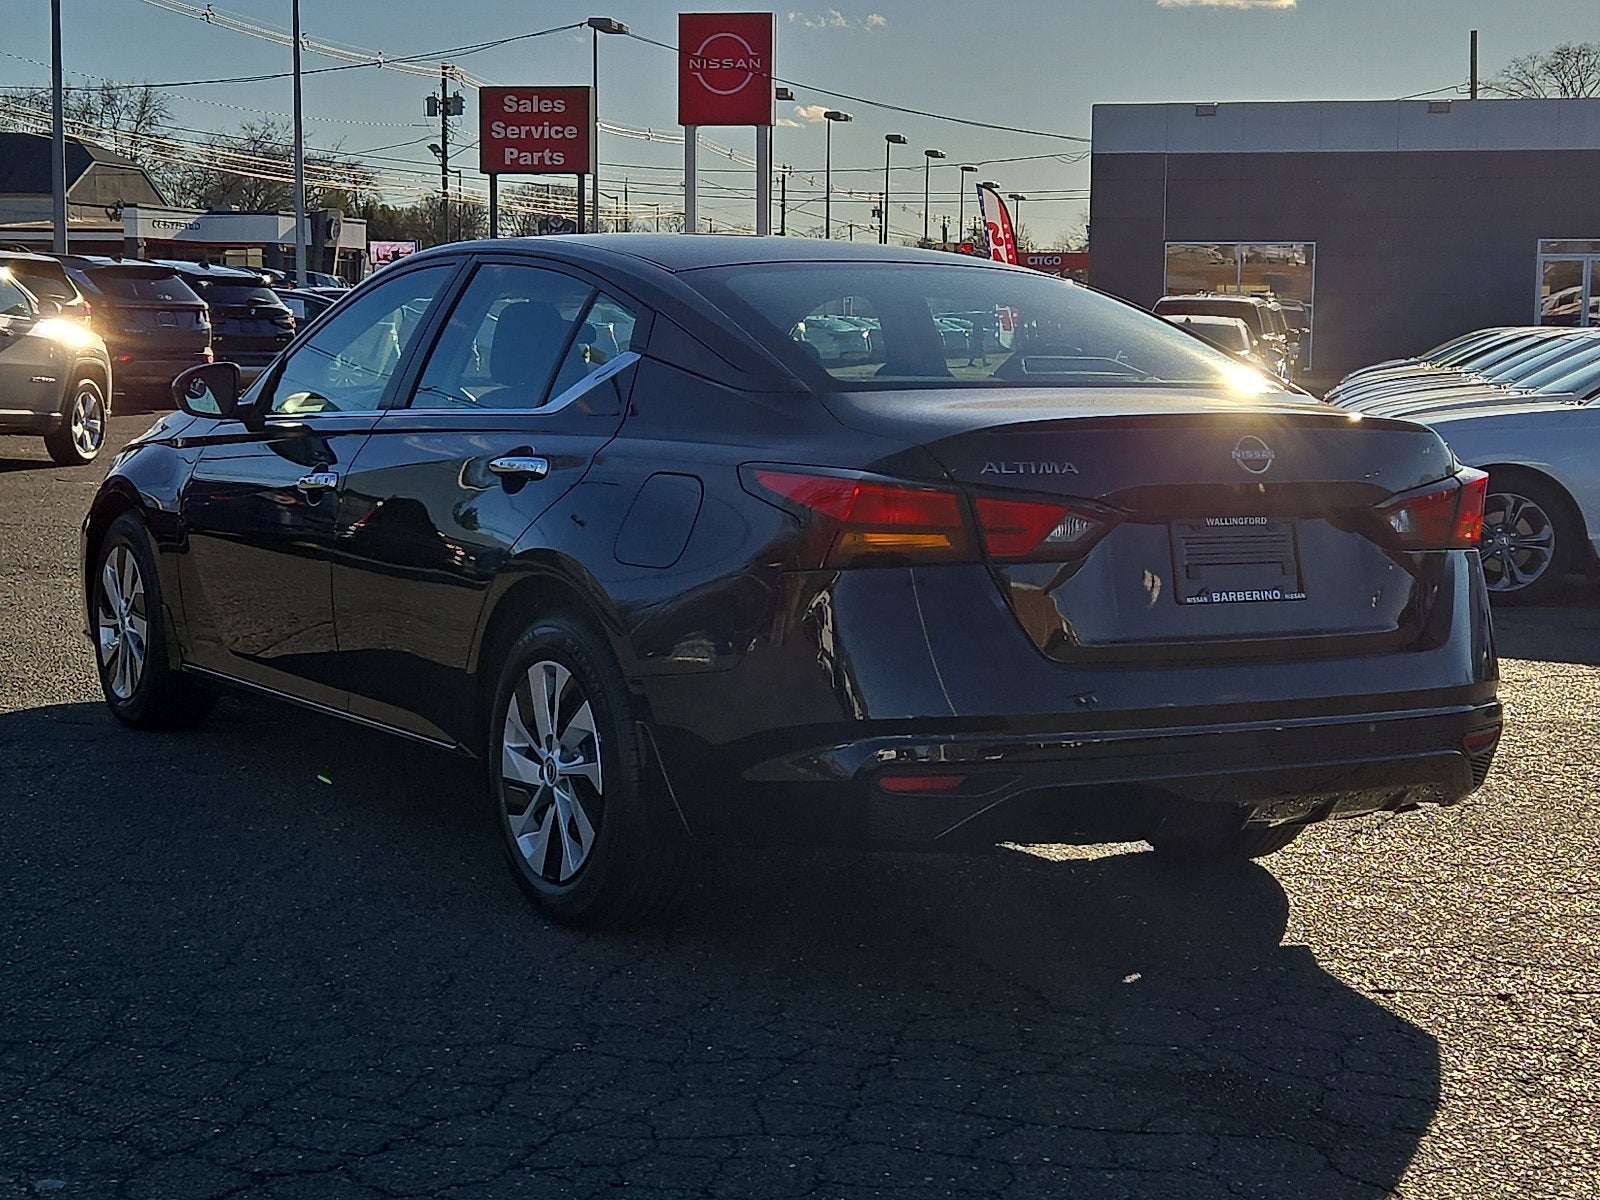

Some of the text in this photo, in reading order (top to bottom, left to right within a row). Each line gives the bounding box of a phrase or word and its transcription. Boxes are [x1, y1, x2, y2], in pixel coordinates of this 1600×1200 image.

[689, 58, 761, 69] NISSAN
[503, 94, 566, 113] Sales
[491, 121, 578, 139] Service
[504, 147, 565, 165] Parts
[1027, 256, 1062, 265] CITGO
[1232, 449, 1275, 459] NISSAN
[980, 461, 1079, 475] ALTIMA
[1206, 516, 1268, 526] WALLINGFORD
[1211, 589, 1281, 603] BARBERINO
